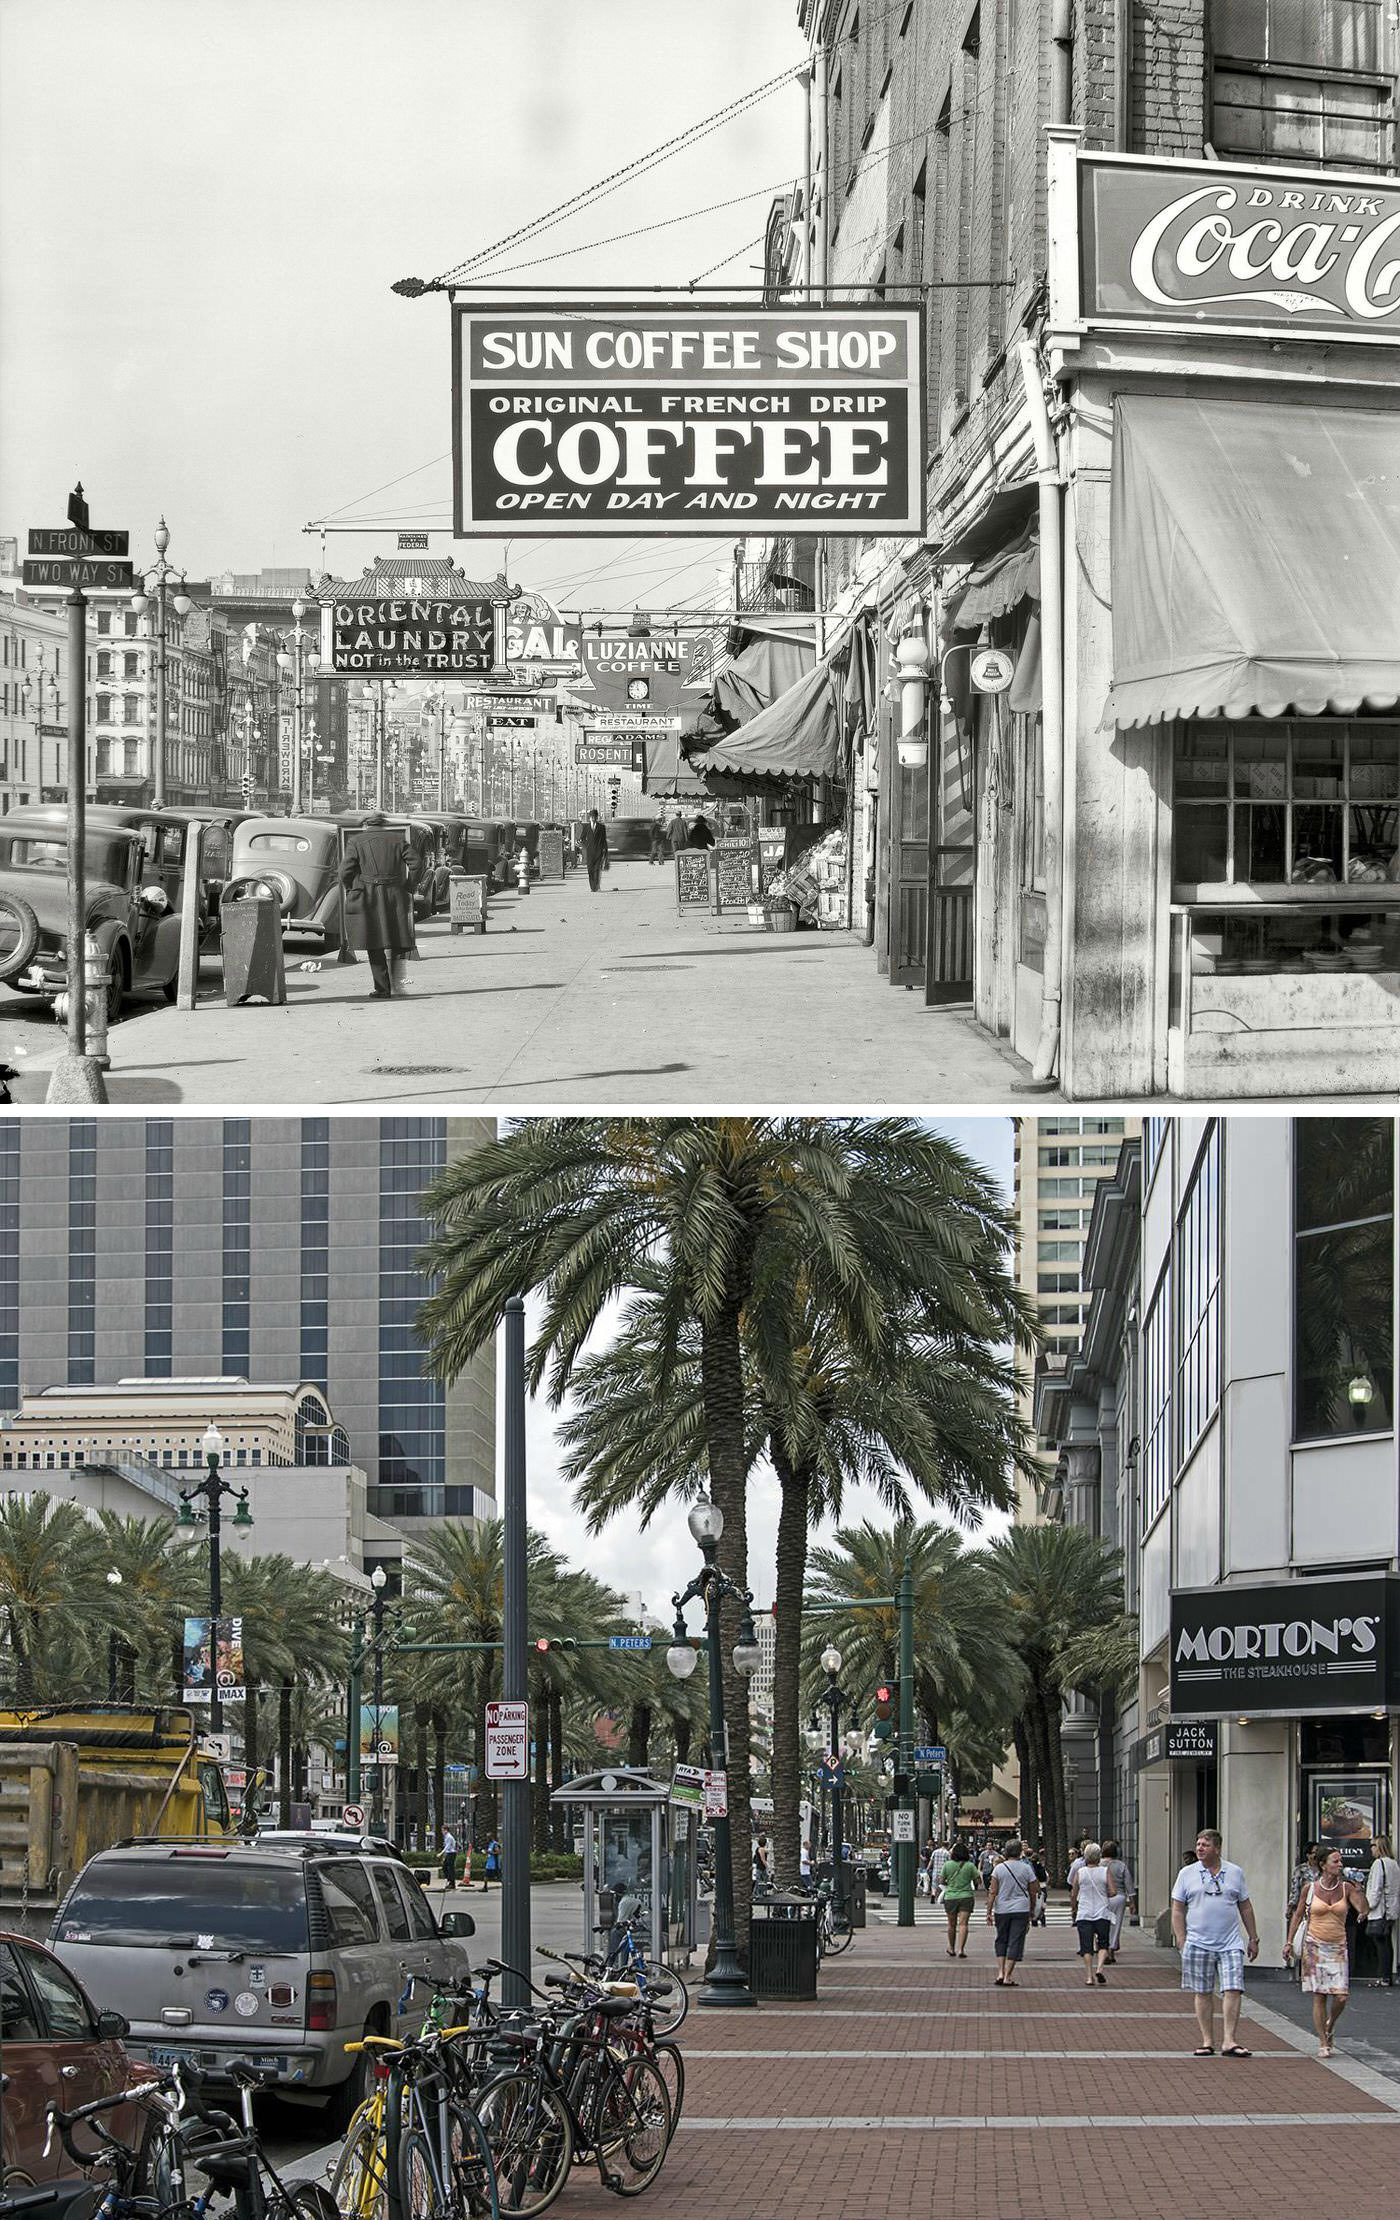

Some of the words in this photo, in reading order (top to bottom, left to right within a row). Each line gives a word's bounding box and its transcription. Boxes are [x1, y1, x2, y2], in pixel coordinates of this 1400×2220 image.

[1247, 187, 1385, 217] DRINK
[481, 331, 573, 370] SUN
[585, 331, 761, 370] COFFEE
[776, 331, 897, 370] SHOP
[489, 396, 643, 414] ORIGINAL
[661, 396, 790, 414] FRENCH
[810, 396, 887, 414] DRIP
[492, 417, 889, 486] COFFEE
[495, 492, 592, 510] OPEN
[606, 492, 680, 510] DAY
[684, 492, 758, 510] AND
[774, 492, 887, 510] NIGHT
[33, 532, 43, 550] N
[49, 532, 97, 551] FRONT
[103, 533, 122, 552] ST
[28, 563, 61, 582] TWO
[69, 563, 99, 582] WAY
[107, 564, 125, 583] ST
[335, 600, 492, 627] ORIENTAL
[335, 631, 494, 650] LAUNDRY
[587, 641, 689, 660] LUZIANNE
[335, 653, 375, 669] NOT
[376, 653, 392, 667] in
[395, 652, 420, 666] the
[424, 653, 491, 669] TRUST
[596, 661, 680, 673] COFFEE
[466, 696, 552, 710] RESTAURANT
[491, 717, 529, 726] EAT
[600, 718, 675, 726] RESTAURANT
[456, 891, 475, 900] Read
[232, 1618, 242, 1648] DIVE
[1175, 1616, 1377, 1663] MORTON'S
[620, 1638, 650, 1648] PETERS
[1223, 1666, 1246, 1680] THE
[1247, 1663, 1326, 1679] STEAKHOUSE
[220, 1688, 245, 1700] IMAX
[488, 1709, 499, 1724] NO
[500, 1710, 525, 1720] PARKING
[489, 1734, 524, 1745] PASSENGER
[1176, 1727, 1206, 1738] JACK
[496, 1745, 518, 1756] ZONE
[1168, 1738, 1214, 1749] SUTTON
[919, 1749, 925, 1758] N
[926, 1748, 945, 1758] Peters
[678, 1766, 692, 1774] RTA
